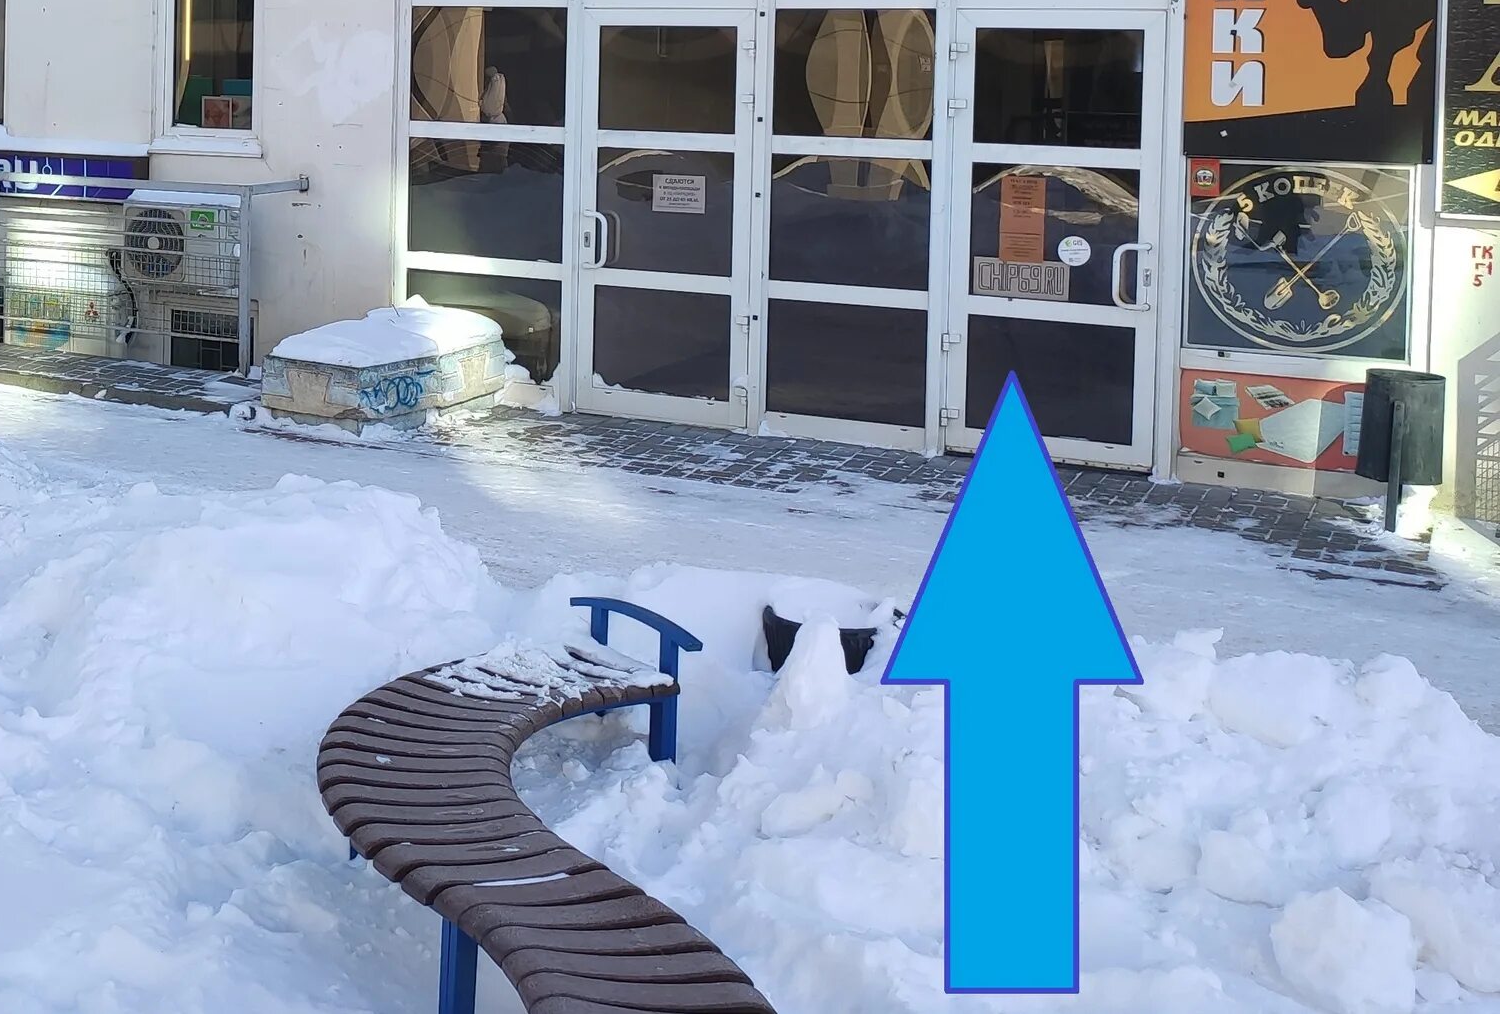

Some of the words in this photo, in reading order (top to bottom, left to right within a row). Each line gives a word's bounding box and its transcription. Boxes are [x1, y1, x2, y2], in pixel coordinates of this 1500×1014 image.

[1453, 110, 1500, 126] МА
[1236, 192, 1254, 213] 5
[1471, 245, 1494, 259] ГК
[978, 261, 1065, 296] CHIP69.RU
[1472, 274, 1483, 287] 5
